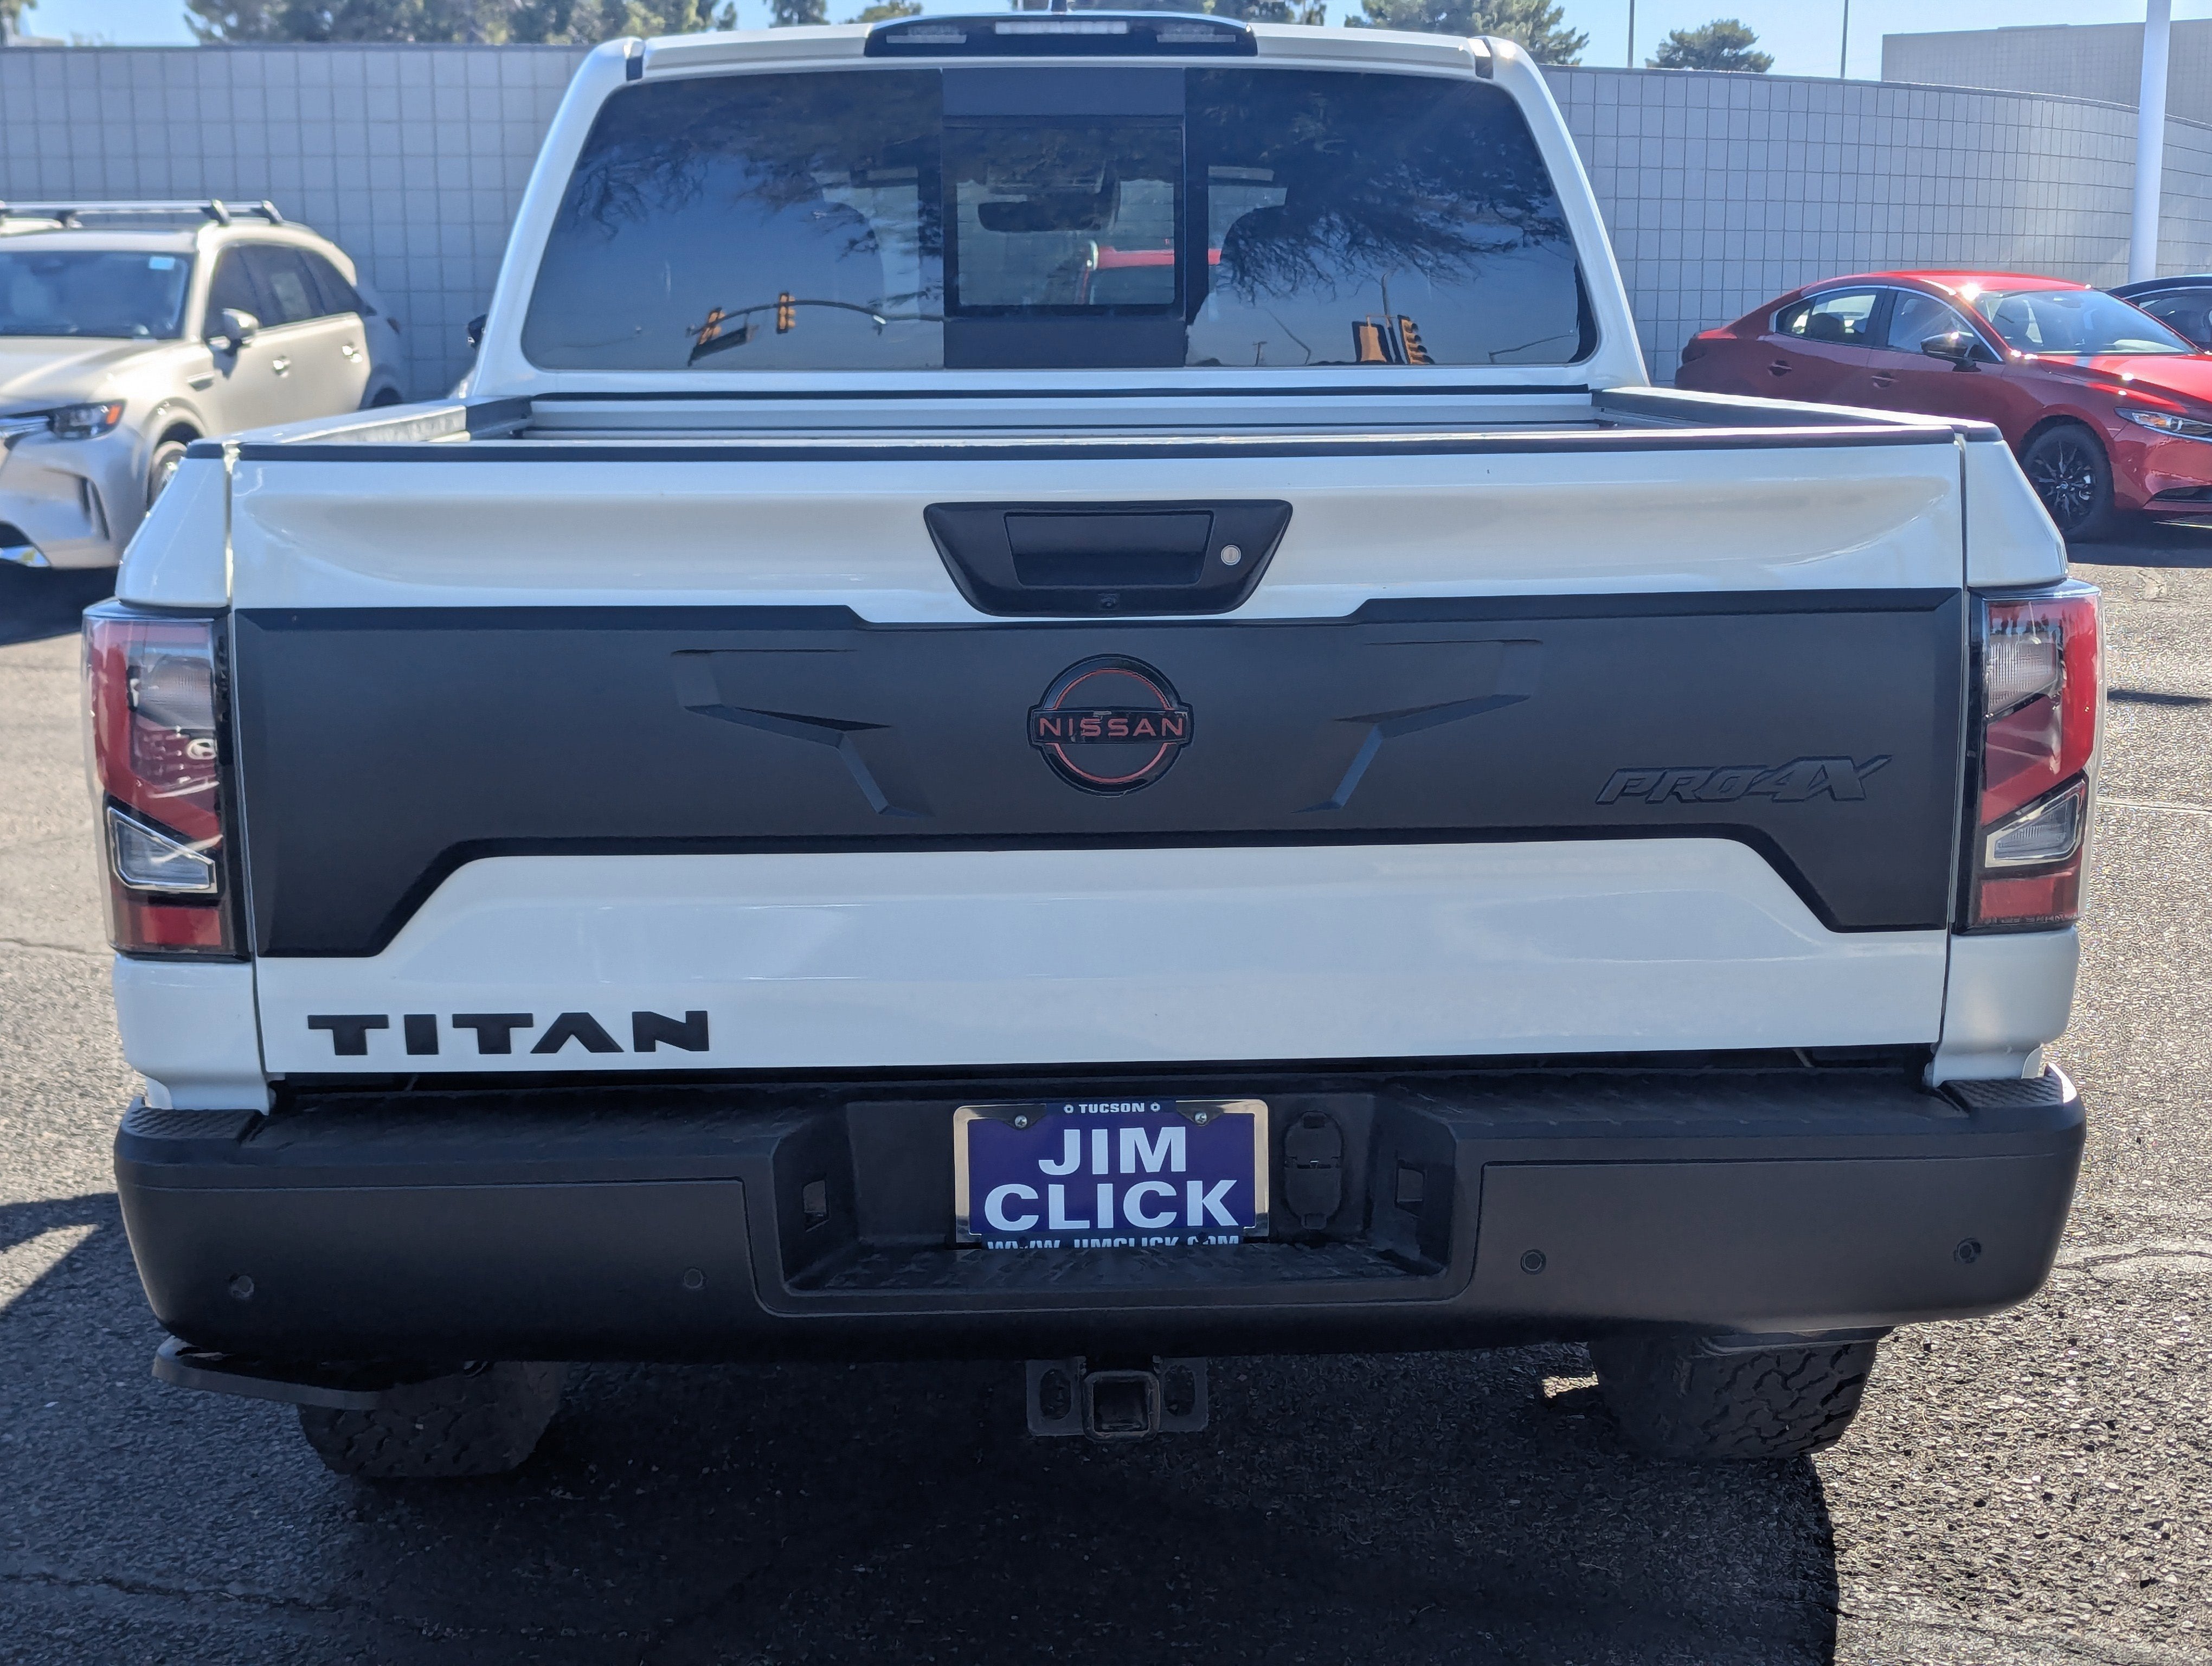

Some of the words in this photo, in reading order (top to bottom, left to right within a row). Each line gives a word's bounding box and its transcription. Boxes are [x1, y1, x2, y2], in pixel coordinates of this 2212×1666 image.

[1039, 717, 1184, 736] NISSAN
[307, 1010, 710, 1056] TITAN
[1078, 1103, 1145, 1113] TUCSON
[1038, 1126, 1186, 1175] JIM
[985, 1180, 1239, 1231] CLICK
